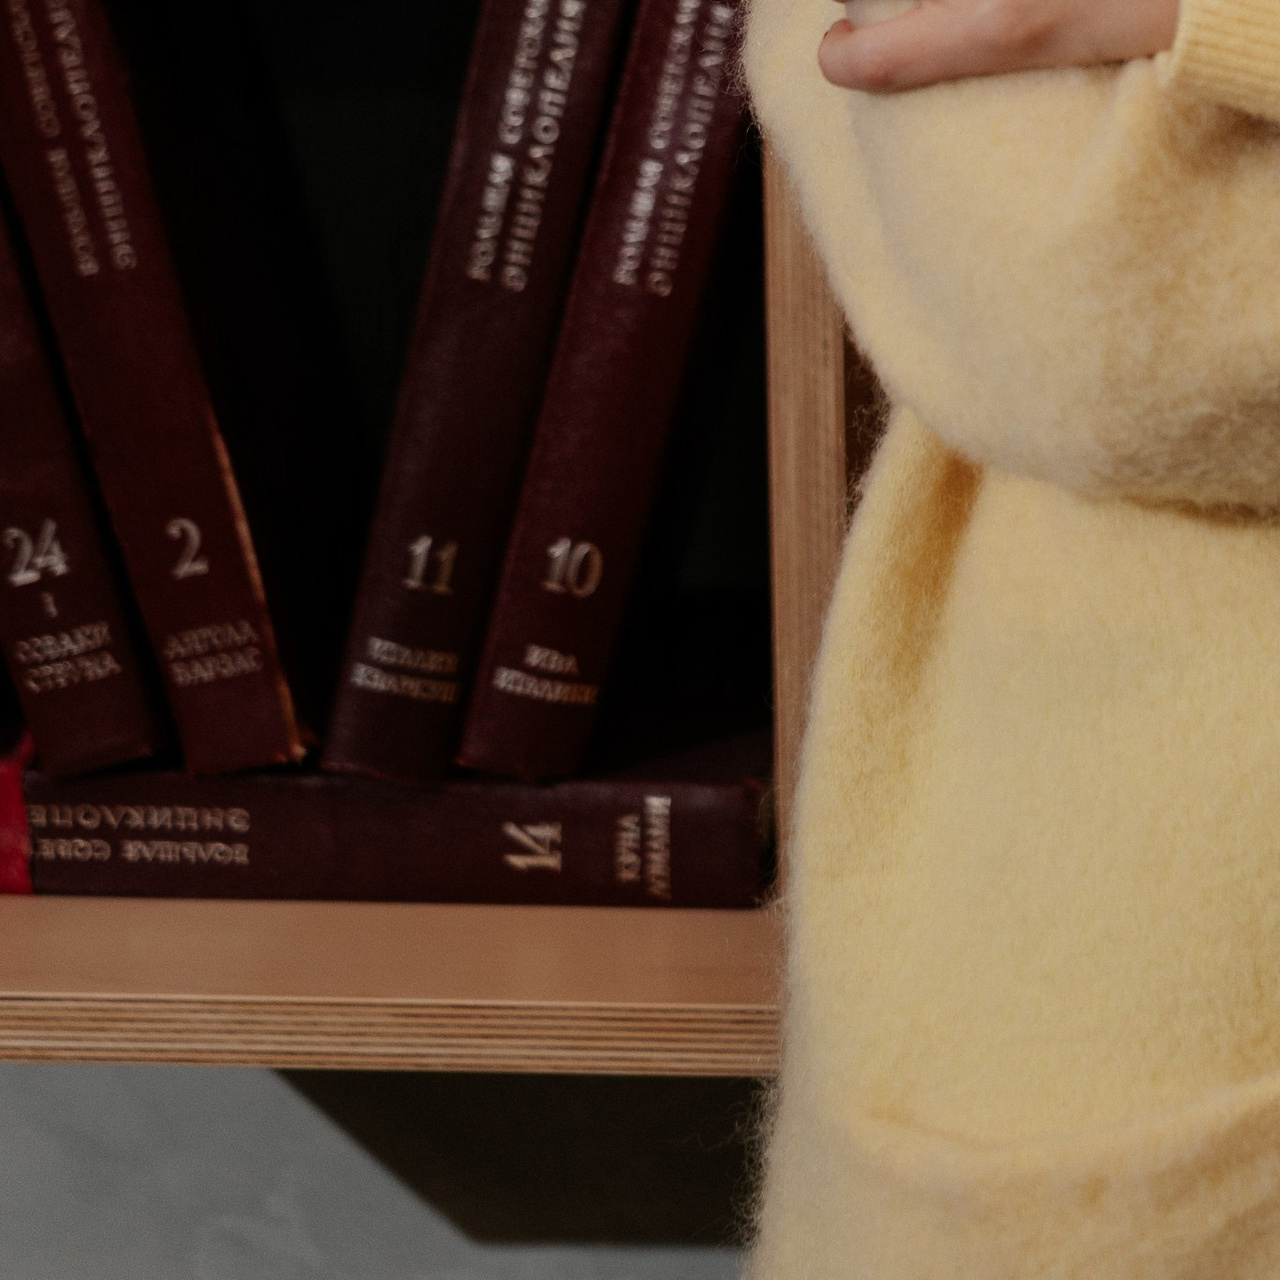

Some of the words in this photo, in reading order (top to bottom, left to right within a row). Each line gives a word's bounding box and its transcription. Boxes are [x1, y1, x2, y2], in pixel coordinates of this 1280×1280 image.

[3, 519, 70, 588] 24
[165, 517, 210, 581] 2
[401, 534, 460, 597] 11
[539, 537, 604, 599] 10
[501, 820, 563, 874] 14
